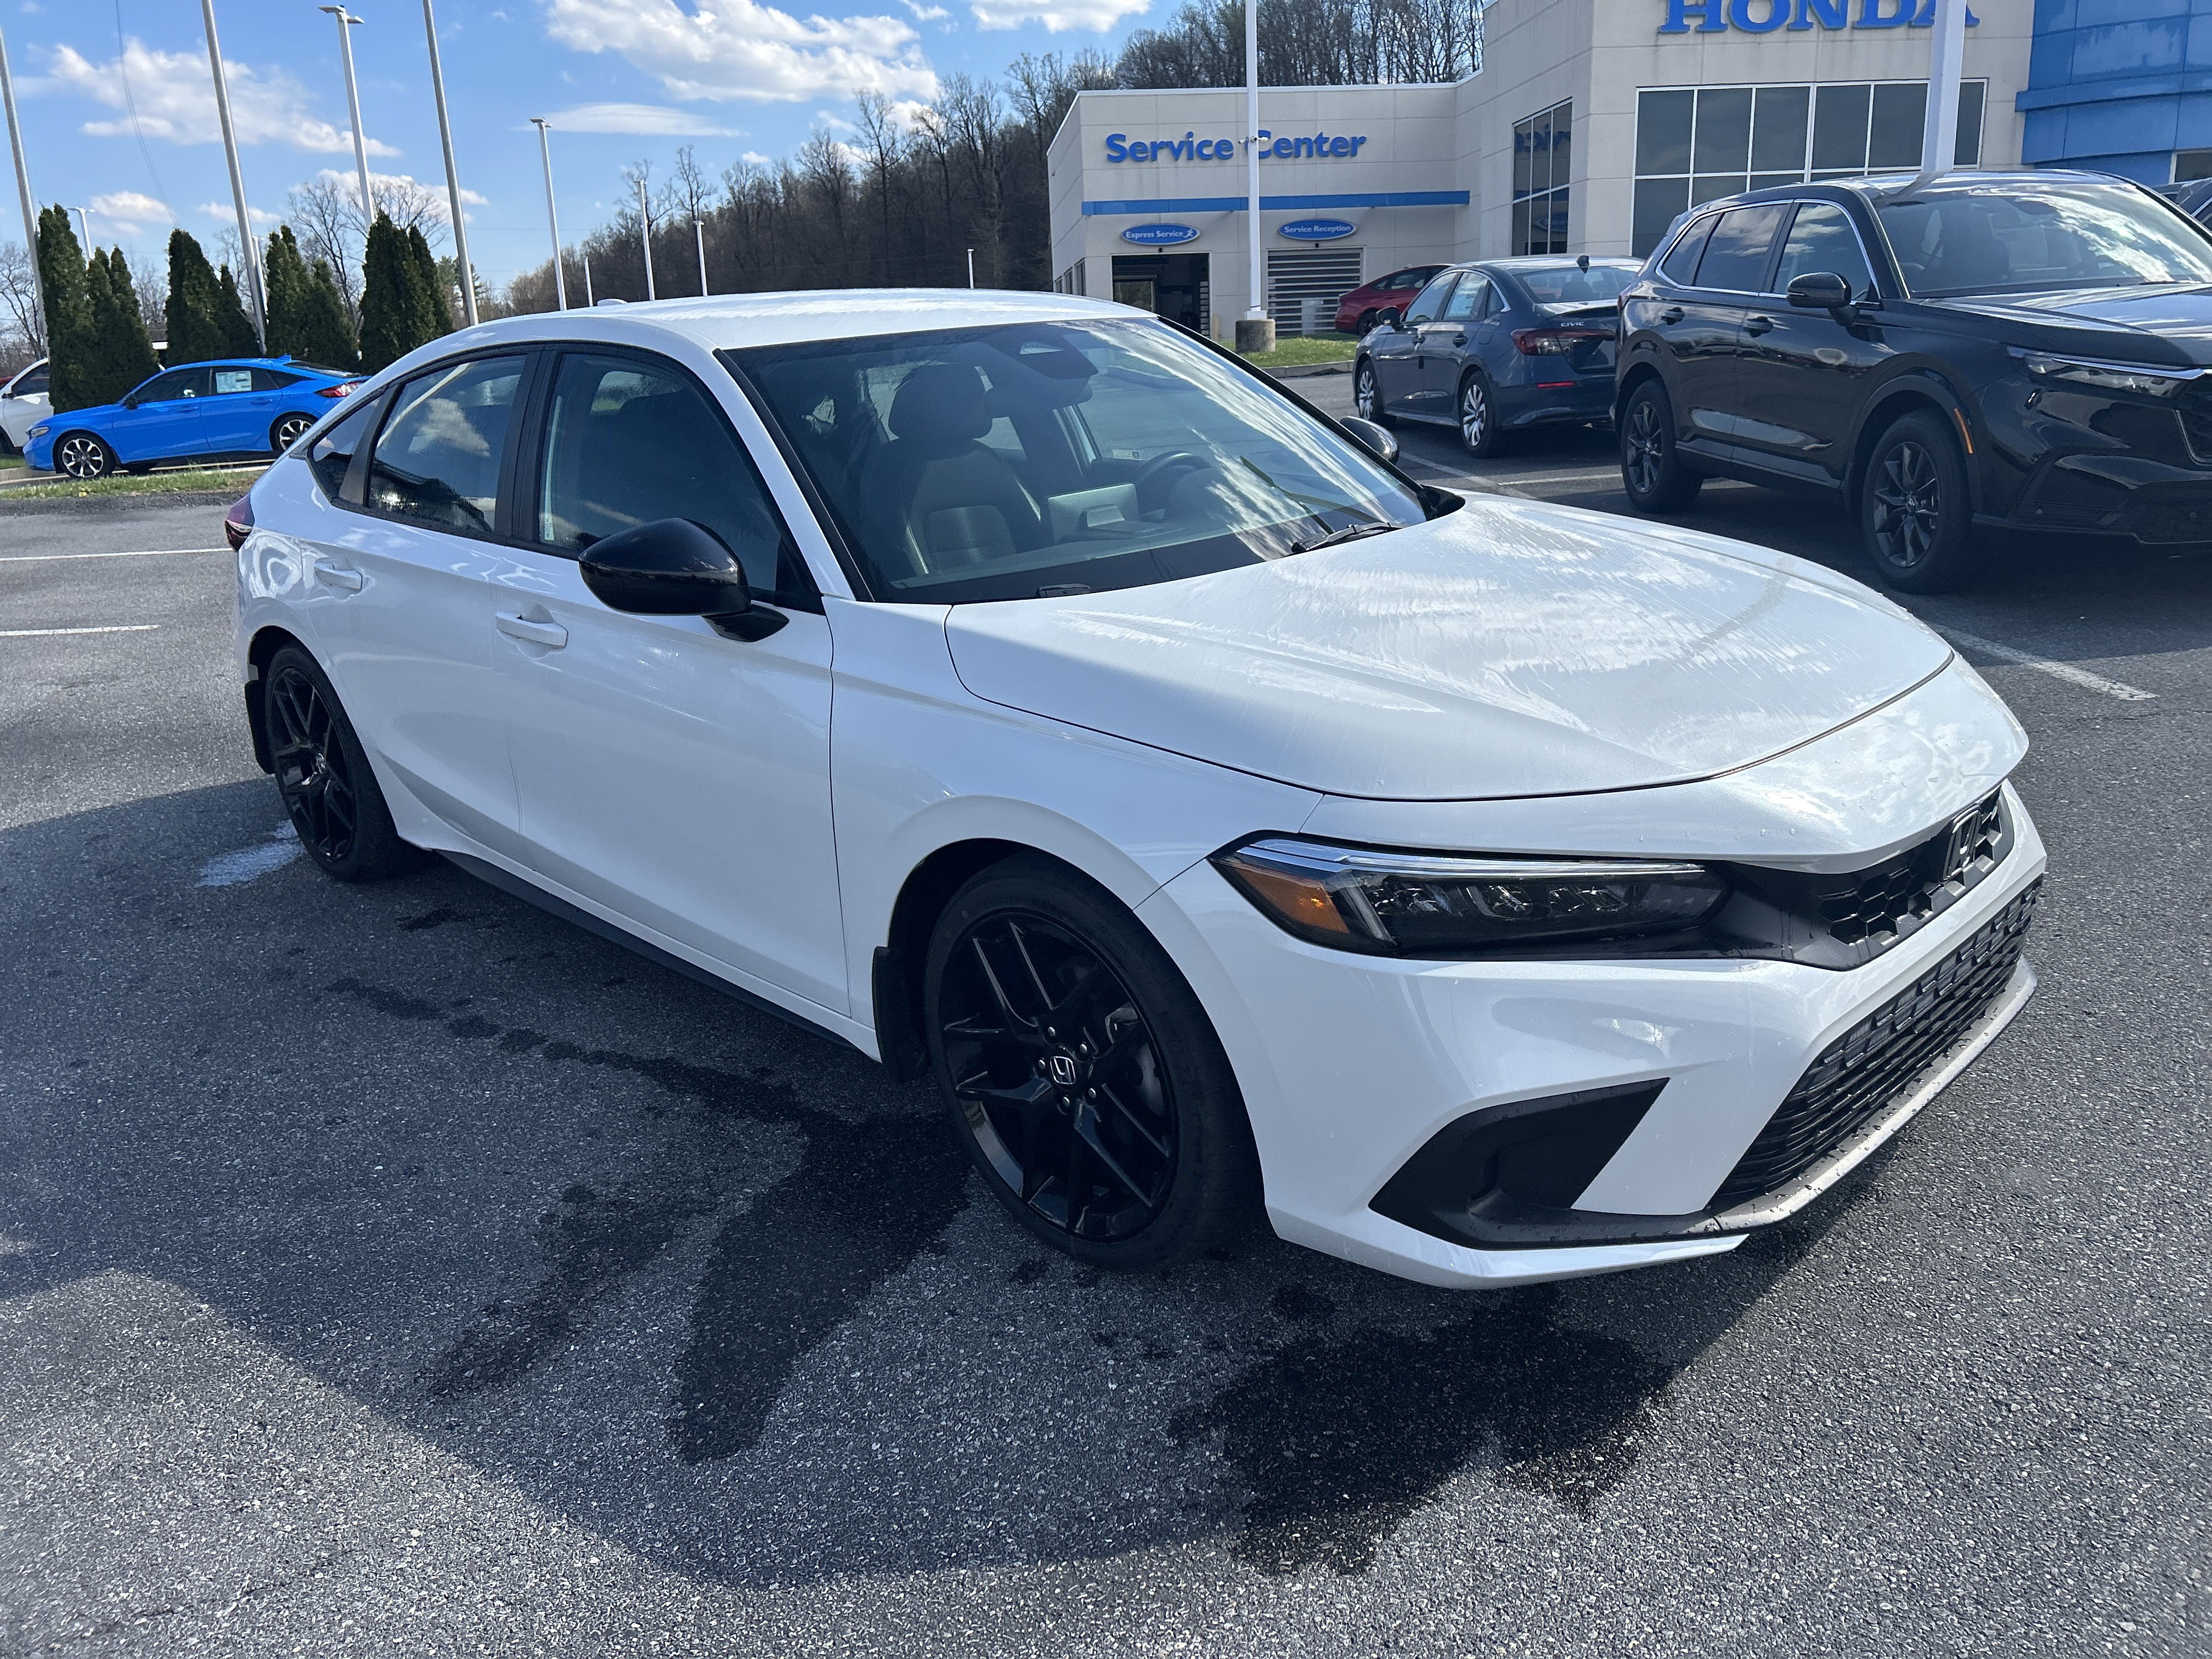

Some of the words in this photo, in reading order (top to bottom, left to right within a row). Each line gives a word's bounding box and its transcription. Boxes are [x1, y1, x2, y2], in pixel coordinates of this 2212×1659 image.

[1105, 131, 1234, 163] Service
[1313, 225, 1351, 233] Reception
[1126, 231, 1154, 240] Express
